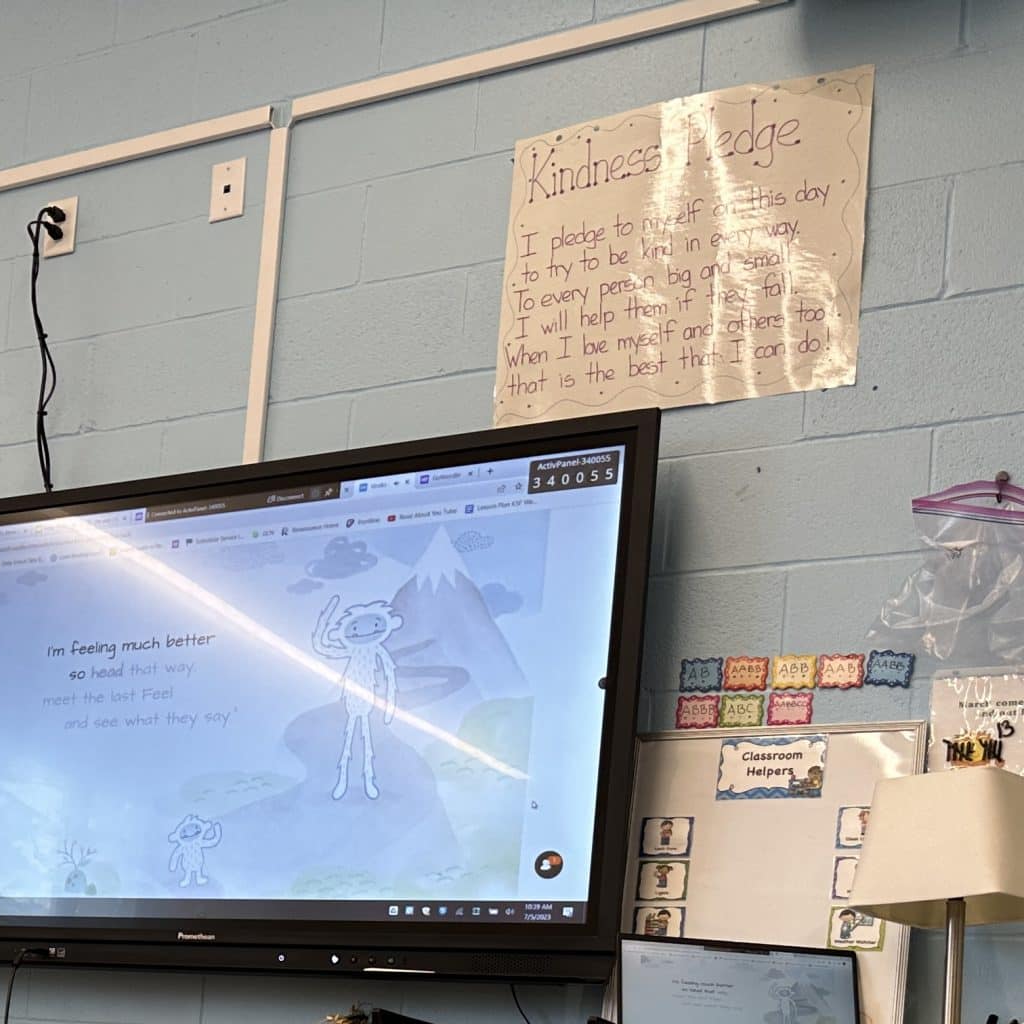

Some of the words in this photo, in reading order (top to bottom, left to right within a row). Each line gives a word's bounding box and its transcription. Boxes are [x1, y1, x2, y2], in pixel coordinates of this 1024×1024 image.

[528, 138, 662, 203] Kindness
[687, 103, 801, 167] Pledge
[520, 231, 539, 258] I
[551, 221, 605, 256] pledge
[613, 214, 633, 237] to
[750, 185, 786, 210] this
[795, 179, 830, 207] day
[521, 263, 539, 285] to
[546, 257, 573, 282] try
[580, 249, 599, 272] to
[609, 243, 628, 265] be
[641, 234, 673, 260] kind
[685, 237, 700, 253] in
[513, 289, 535, 312] To
[540, 287, 589, 308] every
[668, 265, 691, 287] big
[700, 252, 730, 280] and
[743, 240, 791, 270] small
[515, 316, 530, 340] I
[541, 309, 568, 334] will
[580, 304, 614, 331] help
[624, 296, 667, 319] them
[676, 288, 696, 312] if
[505, 344, 548, 368] When
[557, 336, 573, 359] I
[583, 333, 608, 355] love
[617, 319, 677, 354] myself
[683, 313, 713, 340] and
[728, 306, 785, 333] others
[795, 300, 825, 322] too
[507, 368, 548, 396] that
[560, 374, 575, 388] is
[585, 361, 615, 384] the
[628, 351, 668, 377] best
[679, 343, 717, 369] that
[730, 339, 744, 363] I
[754, 343, 785, 359] can
[798, 327, 830, 354] do!
[537, 454, 611, 471] ActivPanel-340055
[71, 640, 117, 660] feeling
[122, 637, 160, 652] much
[166, 634, 216, 648] better
[69, 669, 86, 681] so
[91, 664, 124, 679] head
[130, 662, 159, 676] that
[688, 667, 711, 681] AB
[779, 663, 809, 674] ABB
[826, 663, 856, 674] AAB
[43, 691, 76, 707] meet
[84, 690, 104, 705] the
[111, 690, 136, 703] last
[142, 686, 174, 702] Feel
[727, 703, 754, 715] ABC
[64, 714, 88, 730] and
[93, 718, 118, 728] see
[126, 713, 160, 728] what
[165, 712, 197, 728] they
[742, 751, 803, 762] Classroom
[747, 766, 794, 778] Helpers
